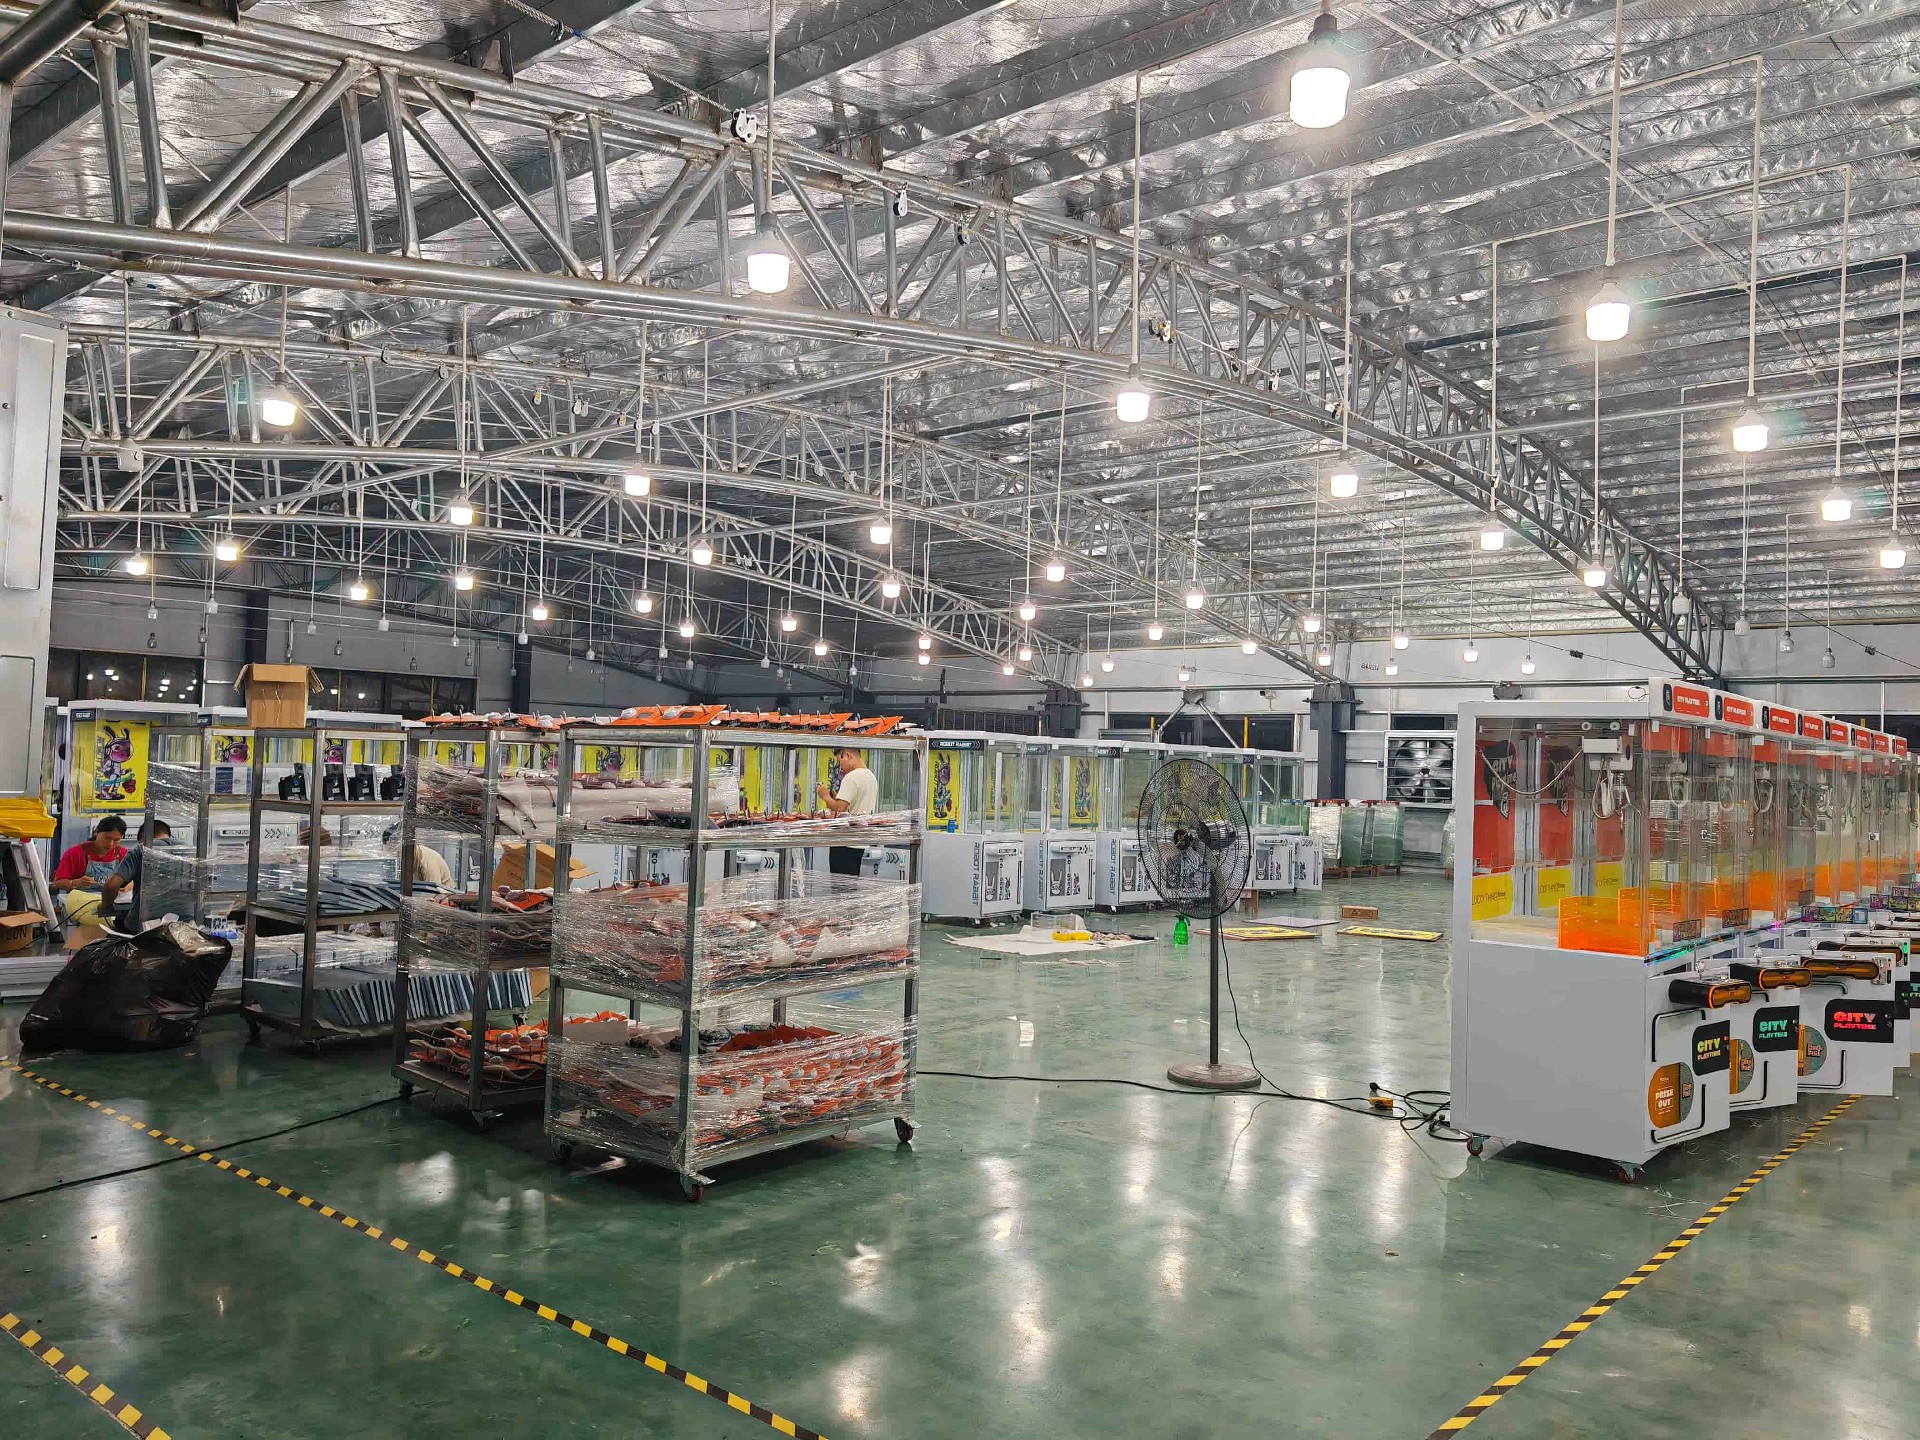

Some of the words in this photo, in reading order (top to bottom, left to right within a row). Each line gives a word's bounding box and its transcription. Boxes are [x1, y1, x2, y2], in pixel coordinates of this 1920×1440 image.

[972, 873, 980, 906] RABBIT
[1833, 1011, 1877, 1022] CITY
[1759, 1019, 1788, 1032] CITY
[1697, 1037, 1721, 1053] CITY
[1697, 1050, 1721, 1061] PLAYTIME
[1657, 1099, 1671, 1108] OUT
